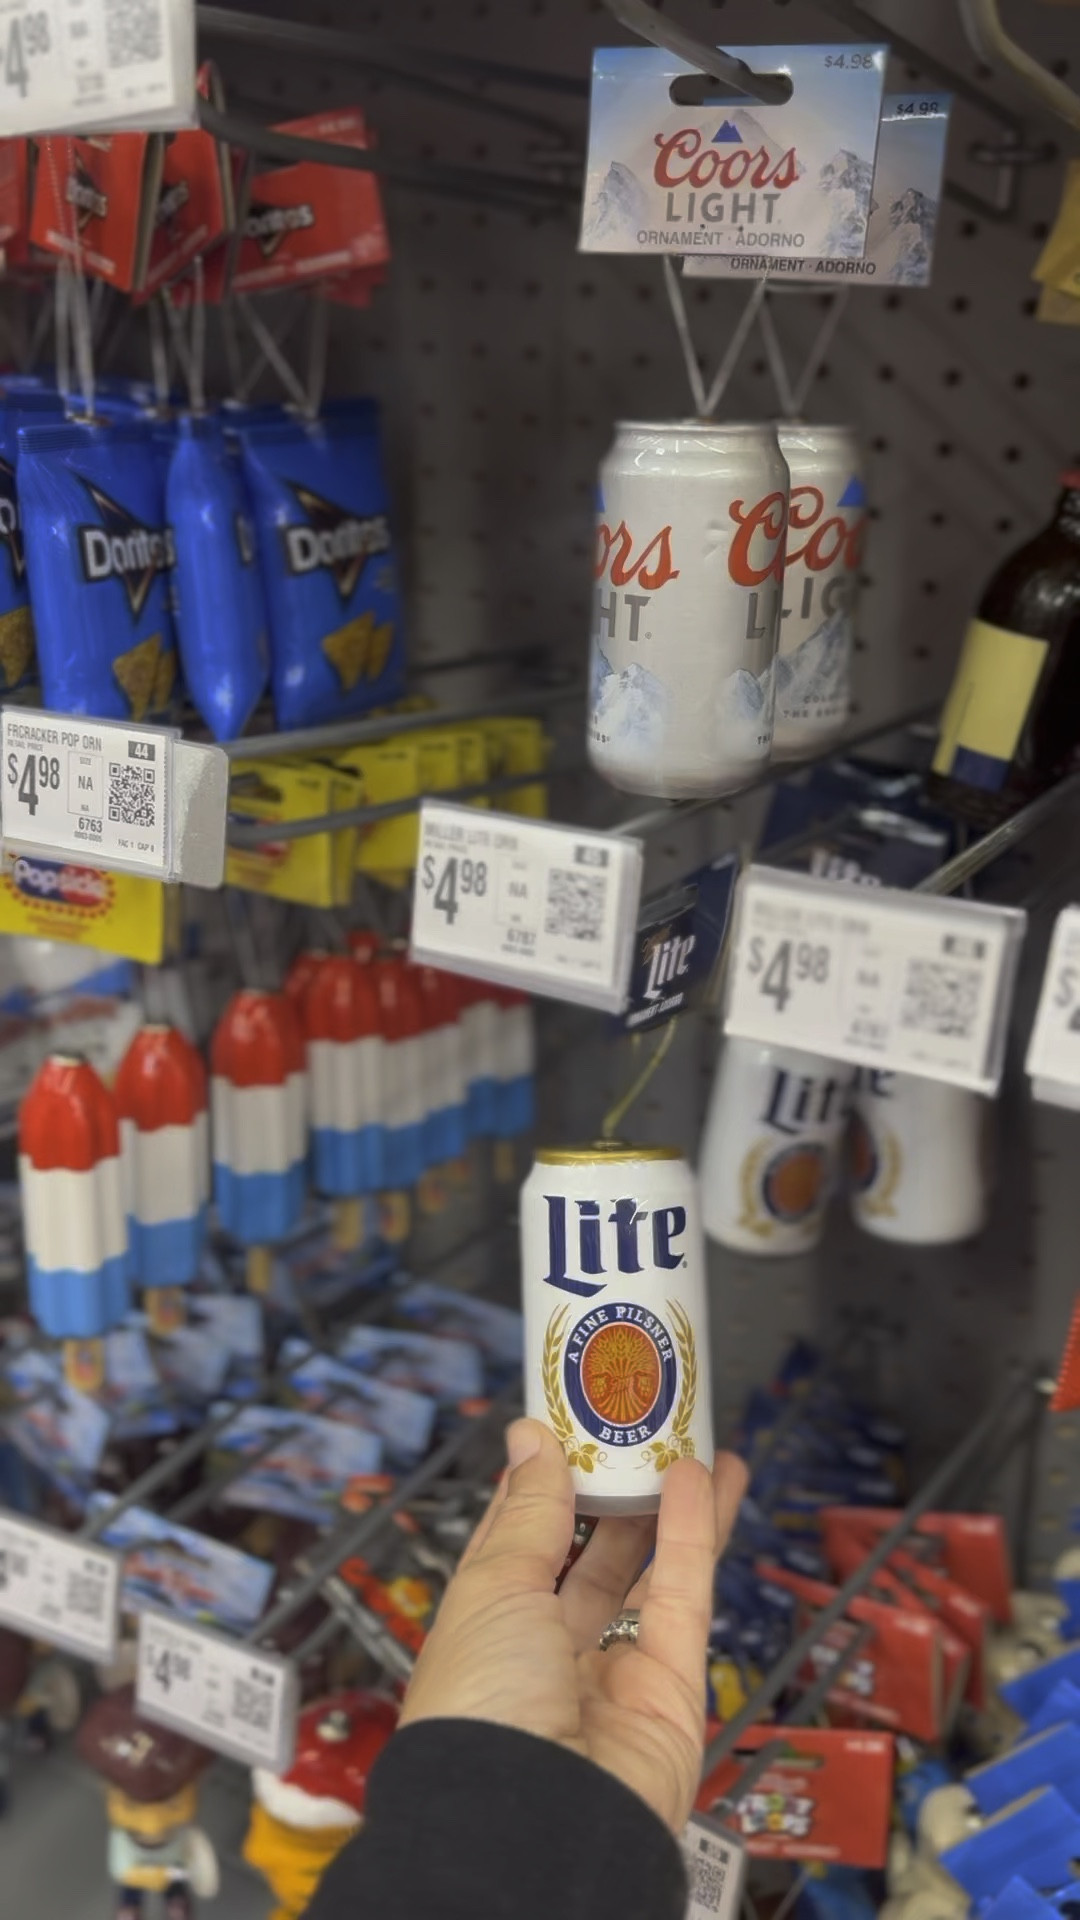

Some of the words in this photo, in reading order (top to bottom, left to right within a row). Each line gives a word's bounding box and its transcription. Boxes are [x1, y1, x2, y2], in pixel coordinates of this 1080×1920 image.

[824, 53, 873, 69] $4.98
[654, 128, 799, 189] Coors
[666, 192, 781, 224] LIGHT
[637, 229, 724, 246] ORNAMENT
[735, 232, 805, 248] ADORNO
[730, 257, 805, 273] ORNAMENT
[815, 260, 876, 276] ADORNO
[7, 723, 59, 744] FRCRACKER
[61, 732, 79, 747] POP
[82, 735, 102, 751] ORN
[134, 742, 149, 759] 44
[78, 775, 93, 791] NA
[78, 817, 103, 833] 6763
[643, 935, 696, 999] Lite
[543, 1195, 687, 1297] Lite
[573, 1309, 609, 1346] FINE
[616, 1306, 673, 1362] PILSNER
[568, 1352, 579, 1364] A
[599, 1425, 652, 1444] BEER
